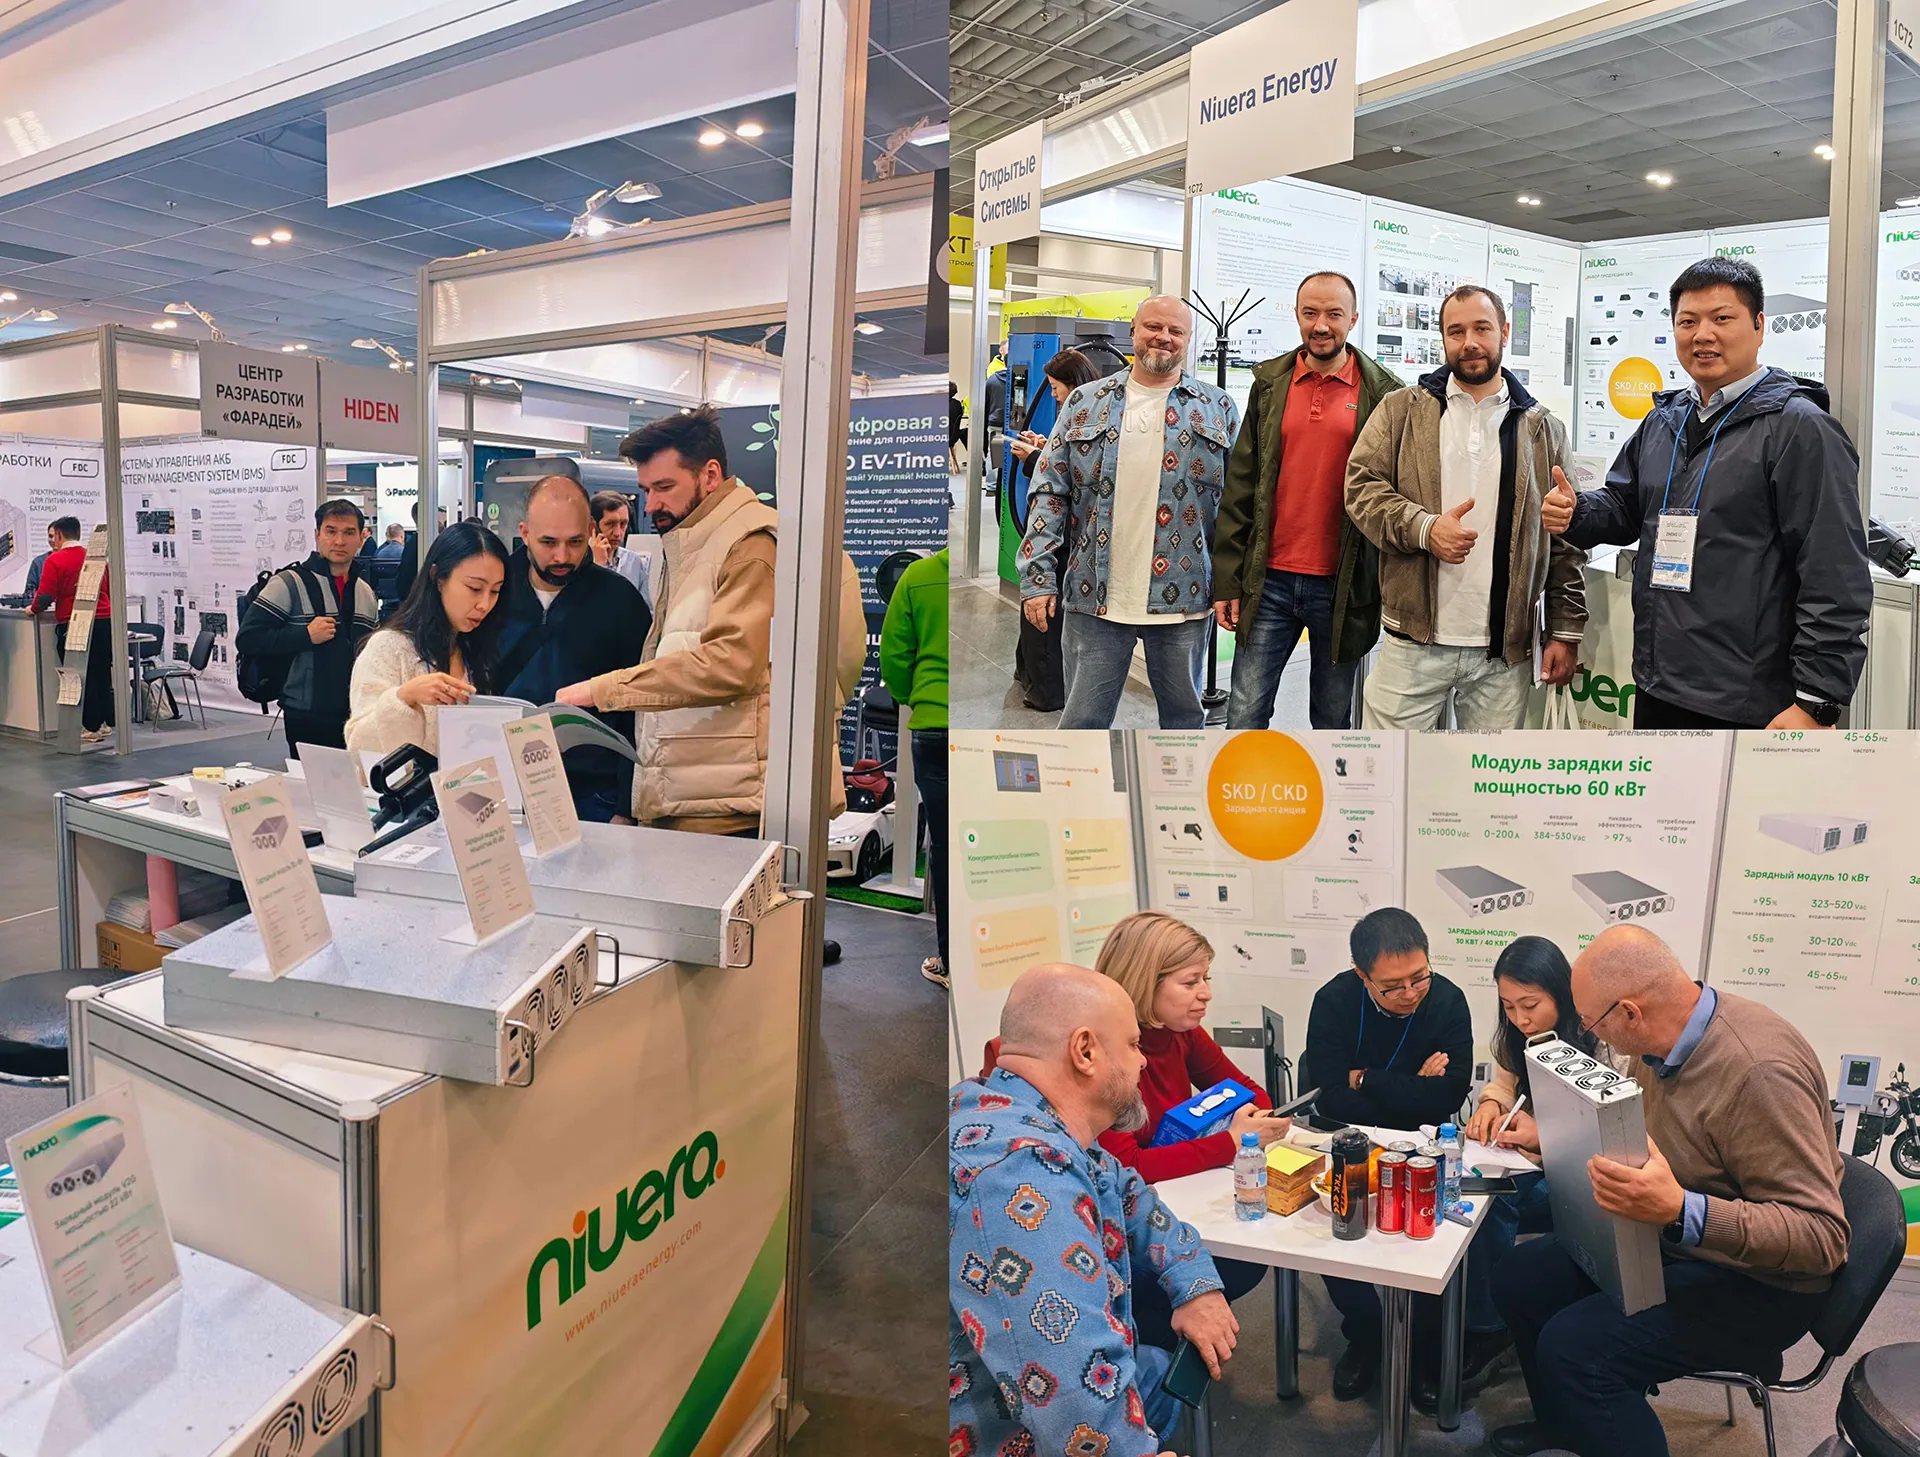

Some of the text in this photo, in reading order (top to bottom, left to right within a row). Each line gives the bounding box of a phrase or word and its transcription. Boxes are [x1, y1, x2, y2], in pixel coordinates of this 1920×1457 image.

[1894, 19, 1913, 49] 1C72
[1200, 58, 1338, 125] Niuera Energy
[979, 155, 1036, 192] Открытые
[1188, 183, 1203, 194] 1C72
[981, 192, 1031, 223] Системы
[239, 363, 283, 383] ЦЕНТР
[217, 384, 304, 408] РАЗРАБОТКИ
[344, 398, 399, 424] HIDEN
[223, 410, 303, 430] «ФАРАДЕЙ»
[874, 437, 893, 446] для
[155, 455, 211, 469] УПРАВЛЕНИЯ
[213, 453, 231, 465] АКБ
[282, 454, 297, 464] FDC
[862, 451, 945, 470] EV-Time
[73, 464, 89, 472] FDC
[148, 471, 206, 484] MANAGEMENT
[207, 470, 240, 482] SYSTEM
[241, 467, 266, 481] (BMS)
[868, 473, 914, 482] Управляй!
[393, 488, 418, 497] Pando
[911, 498, 939, 506] тарифы
[897, 528, 930, 536] 2Charges
[1681, 730, 1714, 738] службы
[1472, 754, 1653, 775] Модуль зарядки sic
[1222, 783, 1256, 800] SKD
[1272, 784, 1308, 801] CKD
[1474, 781, 1646, 797] мощностью 60 кВт
[1225, 804, 1306, 815] Зарядная станция
[1744, 869, 1870, 883] Зарядный модуль 10 кВт
[565, 1221, 702, 1343] www.niueraenergy.com
